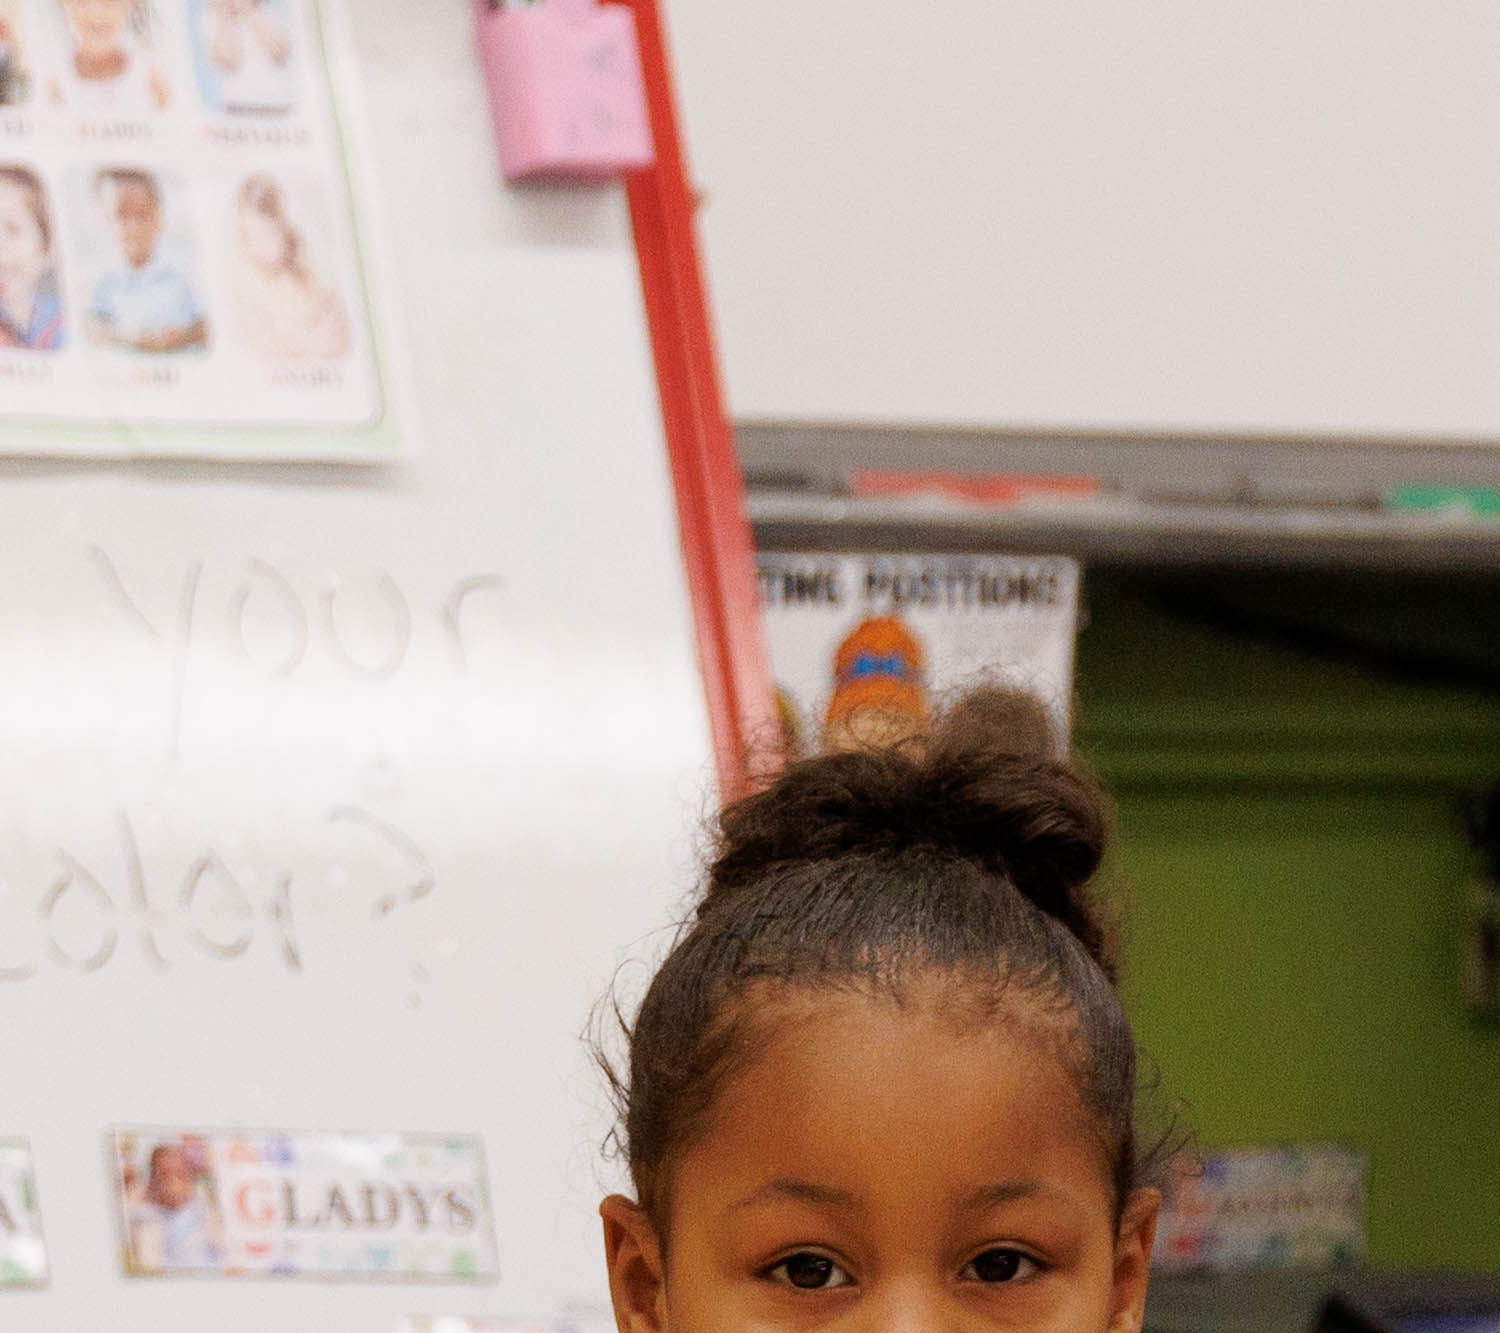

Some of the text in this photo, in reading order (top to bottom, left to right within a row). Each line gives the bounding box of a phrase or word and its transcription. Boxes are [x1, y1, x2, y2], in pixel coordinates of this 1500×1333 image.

[757, 568, 838, 604] TING
[84, 541, 508, 762] your
[235, 1178, 477, 1233] GLADYS
